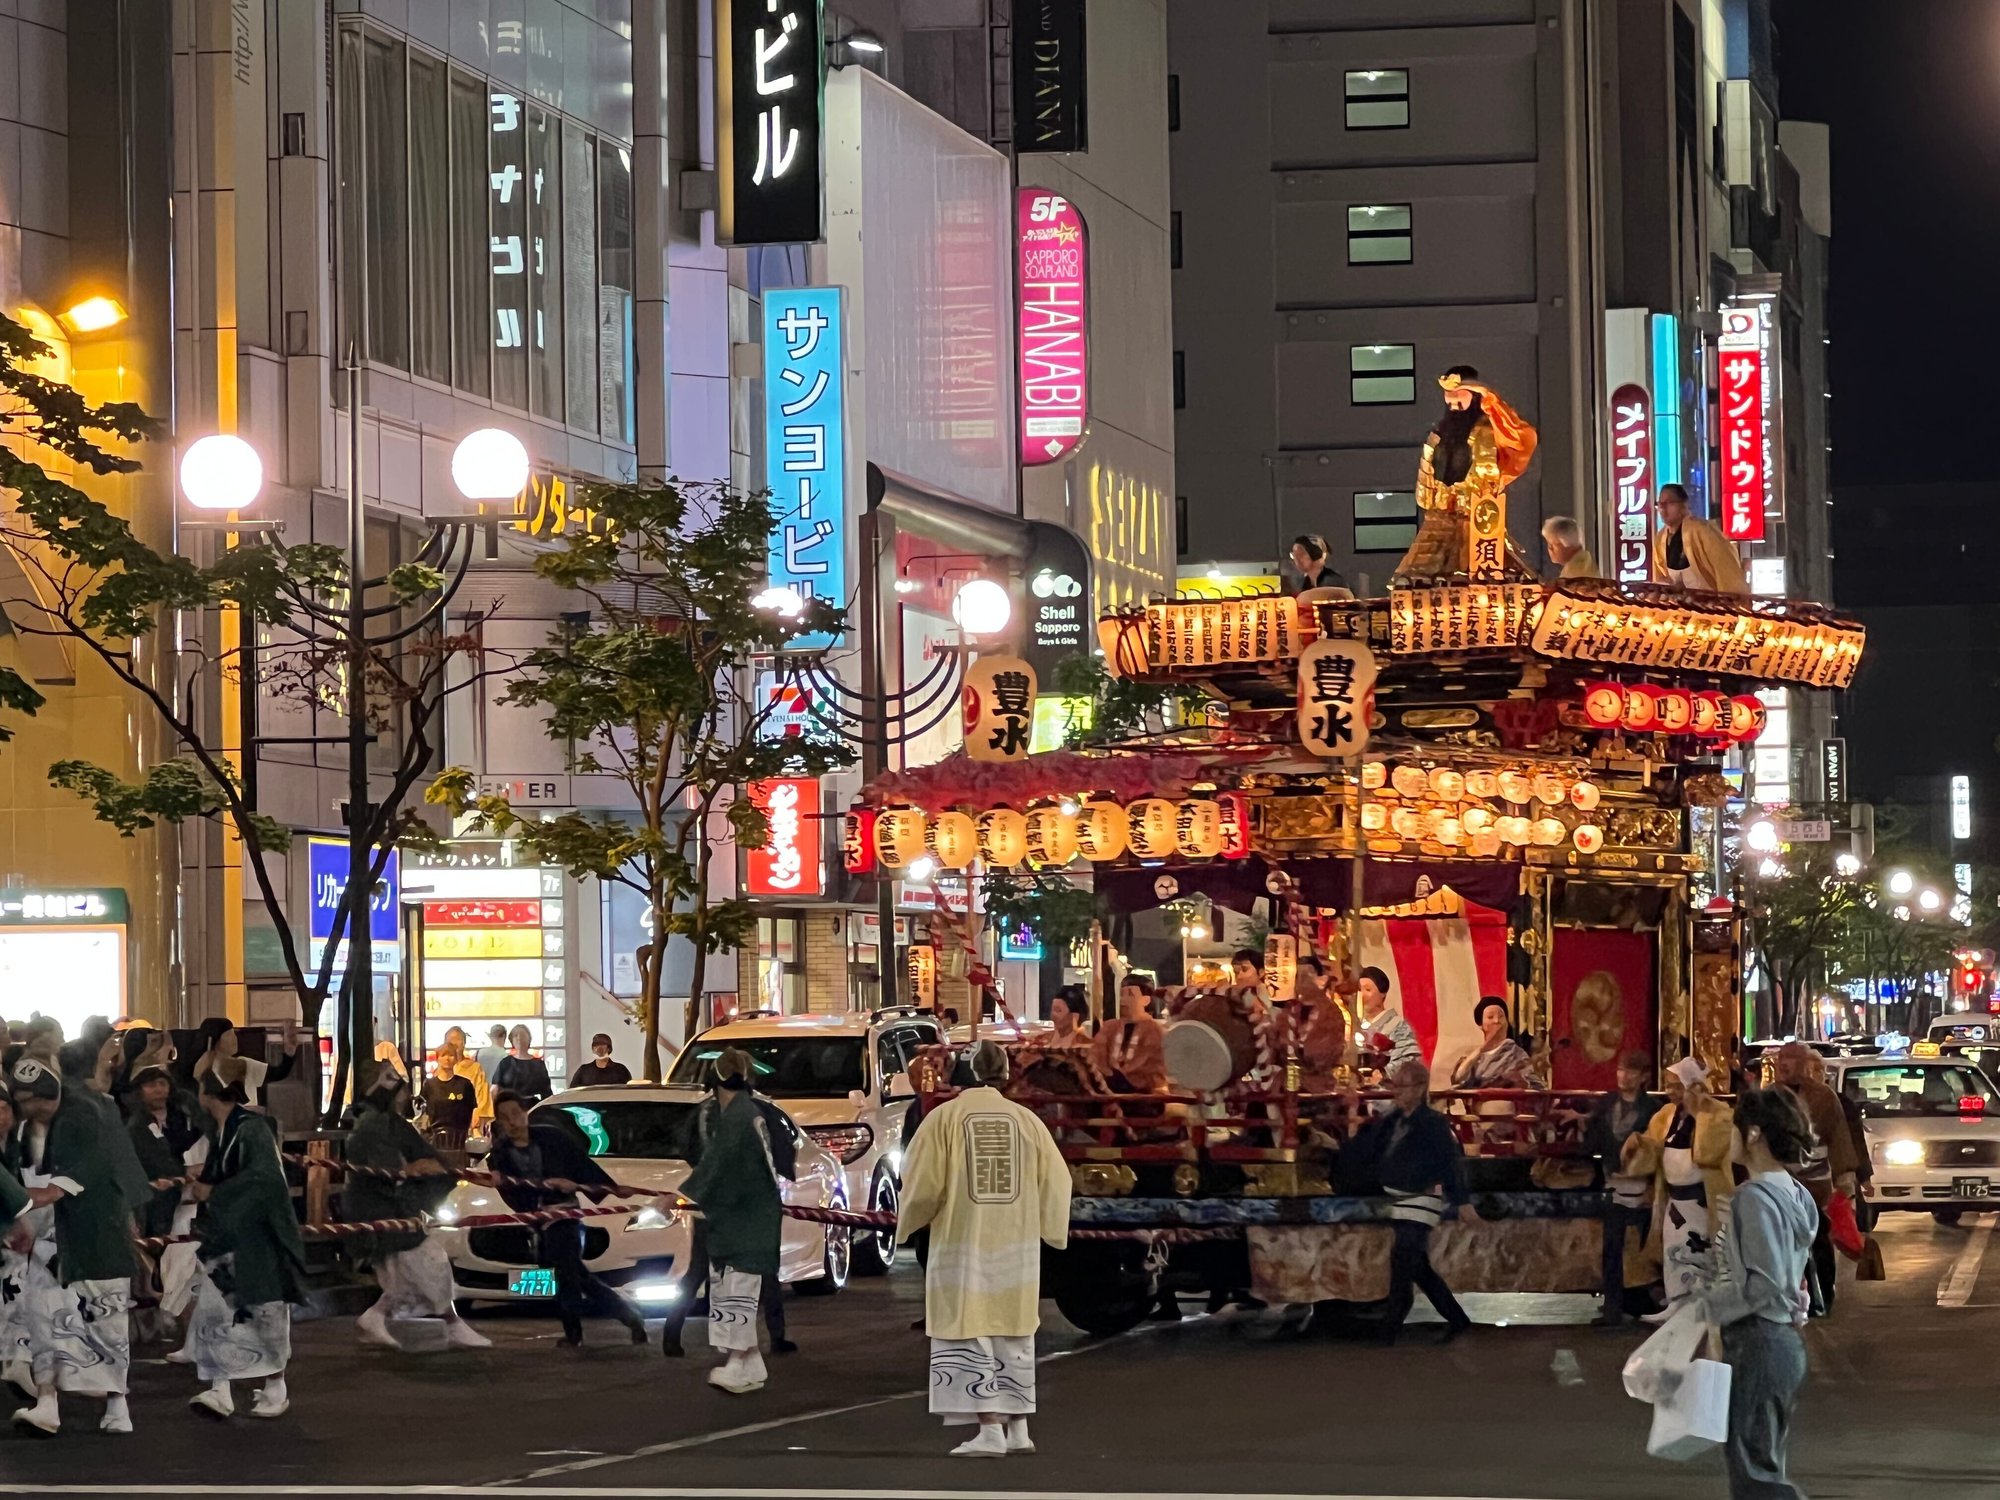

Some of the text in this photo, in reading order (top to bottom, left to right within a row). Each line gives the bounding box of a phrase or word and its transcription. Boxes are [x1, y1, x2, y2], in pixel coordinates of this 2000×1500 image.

[752, 0, 799, 186] ビル
[1034, 40, 1060, 141] DIANA
[1030, 196, 1067, 221] 5F
[1025, 249, 1078, 264] SAPPORO
[1025, 264, 1078, 278] SOAPLAND
[1024, 282, 1081, 409] HANABI
[1040, 606, 1075, 619] Shell
[1035, 622, 1080, 634] Sapporo
[1037, 638, 1054, 646] Boys
[988, 672, 1030, 755] 豊水
[1311, 655, 1355, 748] 豊水
[1827, 746, 1838, 777] JAPAN
